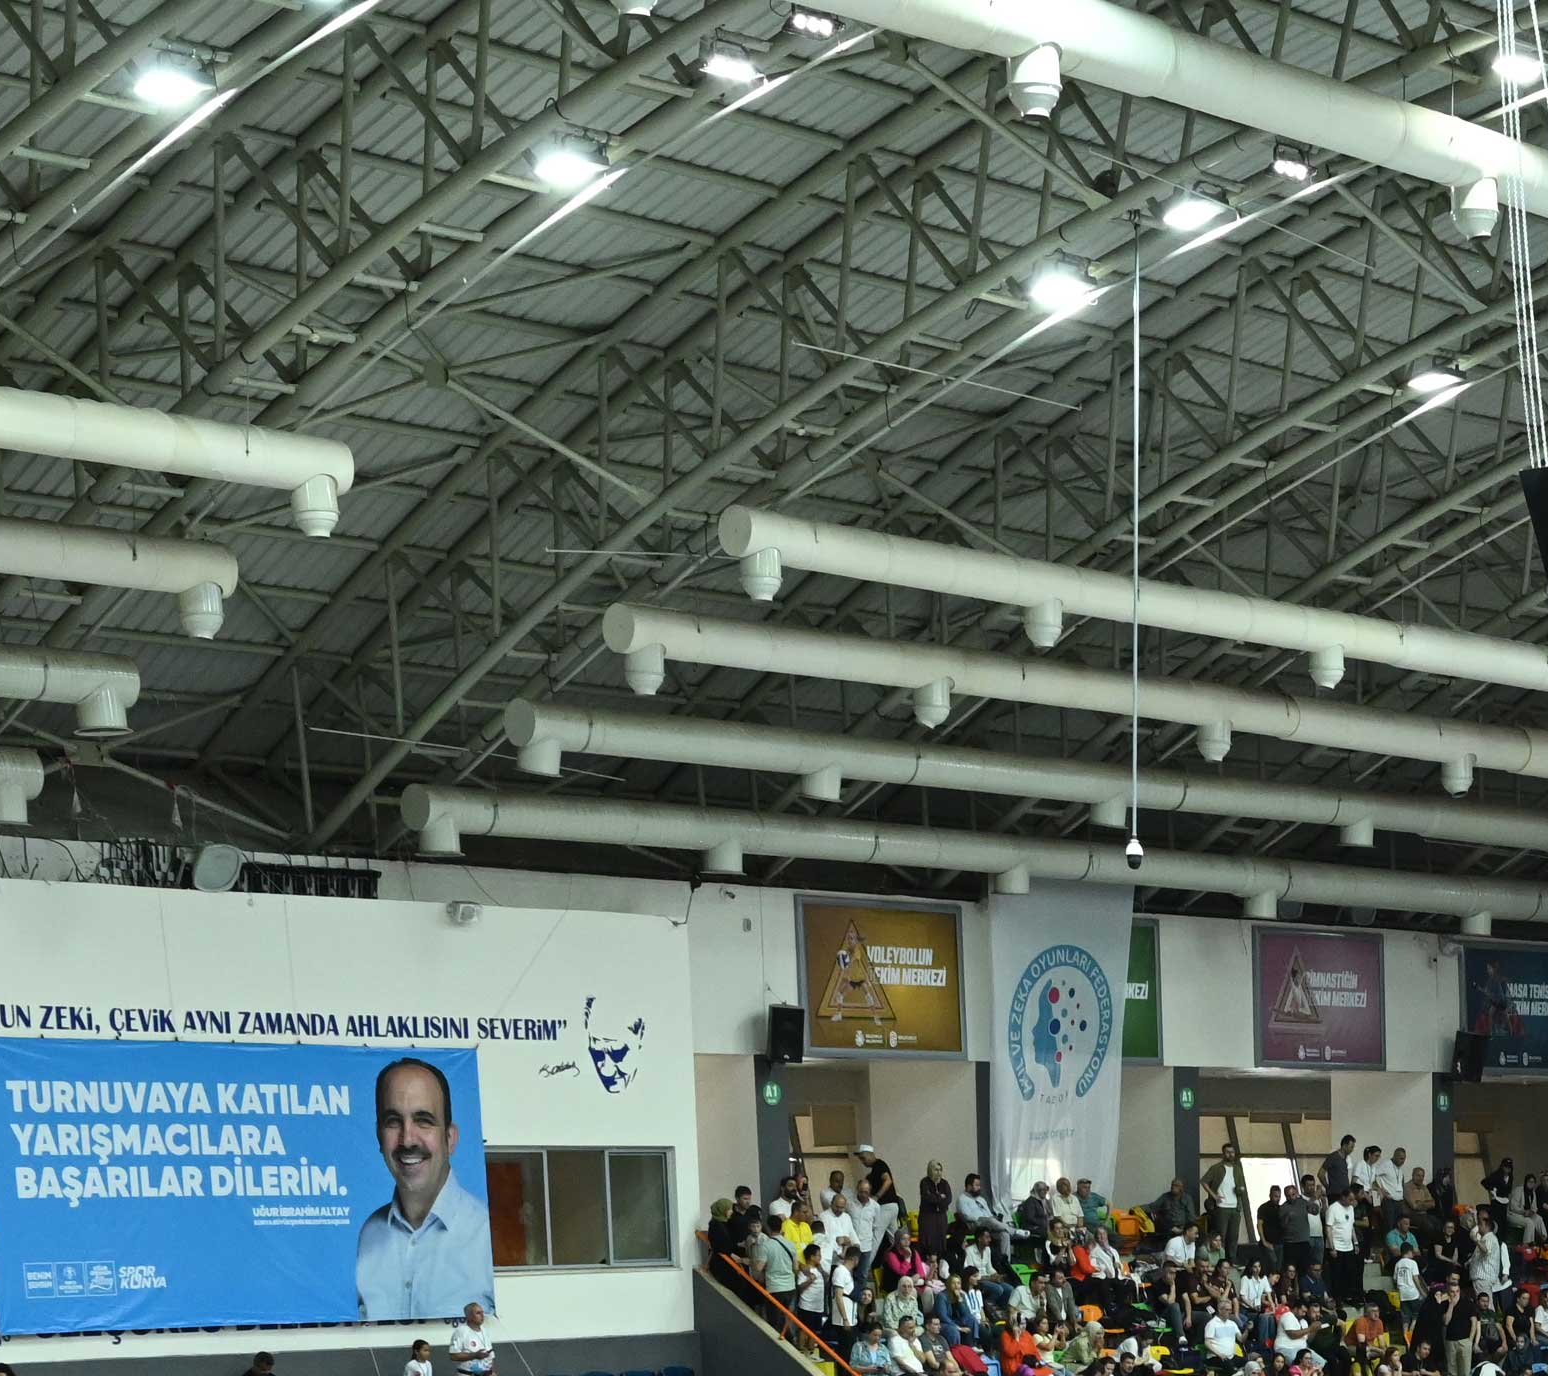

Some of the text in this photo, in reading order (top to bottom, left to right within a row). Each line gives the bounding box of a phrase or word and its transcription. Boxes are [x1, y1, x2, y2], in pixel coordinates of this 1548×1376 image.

[866, 946, 932, 966] VOLEYBOLUN
[902, 966, 946, 986] MERKEZİ
[183, 1011, 231, 1034] AYNI
[238, 1011, 340, 1036] ZAMANDA
[345, 1014, 469, 1040] AHLAKLISINI
[1012, 979, 1032, 1024] ZEKA
[1030, 948, 1091, 977] OYUNLARI
[1078, 966, 1110, 1094] FEDERASYONU
[5, 1080, 350, 1116] TURNUVAYA KATILAN
[766, 1085, 778, 1097] A1
[10, 1123, 286, 1166] YARIŞMACILARA
[15, 1156, 348, 1208] BAŞARILAR DİLERİM.
